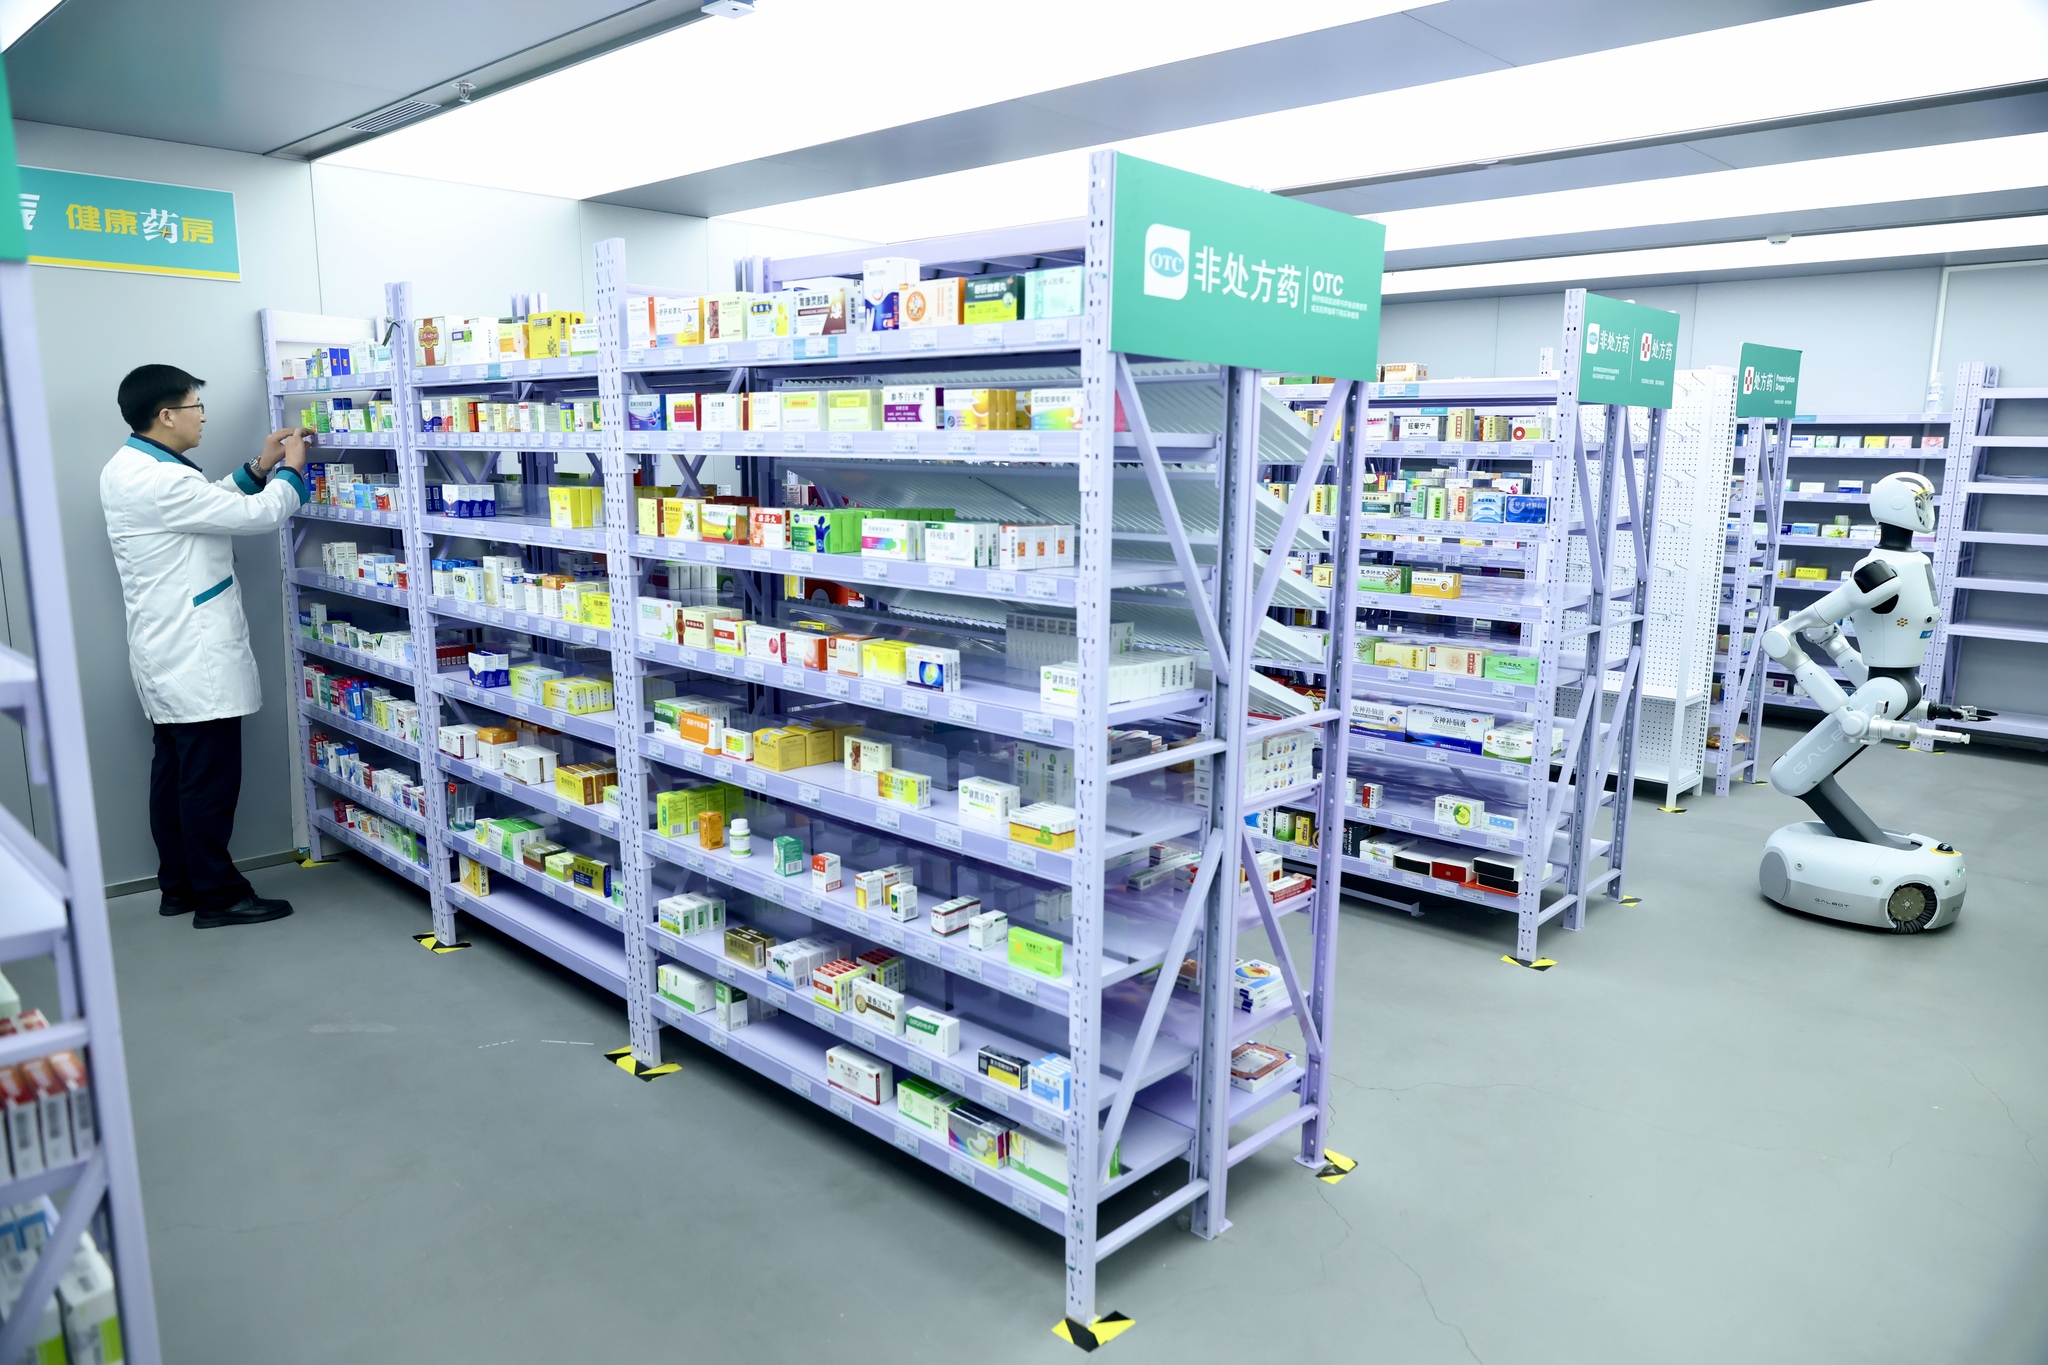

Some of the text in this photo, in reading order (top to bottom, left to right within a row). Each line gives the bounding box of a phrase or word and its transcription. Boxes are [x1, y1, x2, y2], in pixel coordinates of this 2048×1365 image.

[65, 203, 215, 245] 健康药房
[1151, 253, 1184, 274] OTC
[1193, 246, 1302, 308] 非处方药
[1312, 271, 1344, 296] OTC
[798, 294, 830, 308] 胃康灵胶囊
[1599, 329, 1630, 354] 非处方药
[1651, 339, 1673, 361] 处方药
[1753, 371, 1773, 392] 处方药
[1775, 373, 1795, 384] Prescription
[1775, 382, 1785, 393] Drugs
[890, 391, 925, 401] 参苓白术散
[758, 514, 778, 525] 保济丸
[930, 530, 955, 541] 痔疮胶囊
[1052, 674, 1079, 688] 健胃消食
[1353, 705, 1385, 716] 安神补脑液
[1432, 715, 1466, 728] 安神补脑液
[968, 789, 996, 805] 健胃消食片
[1814, 897, 1850, 909] GALBOT
[867, 995, 893, 1014] 藿香正气丸
